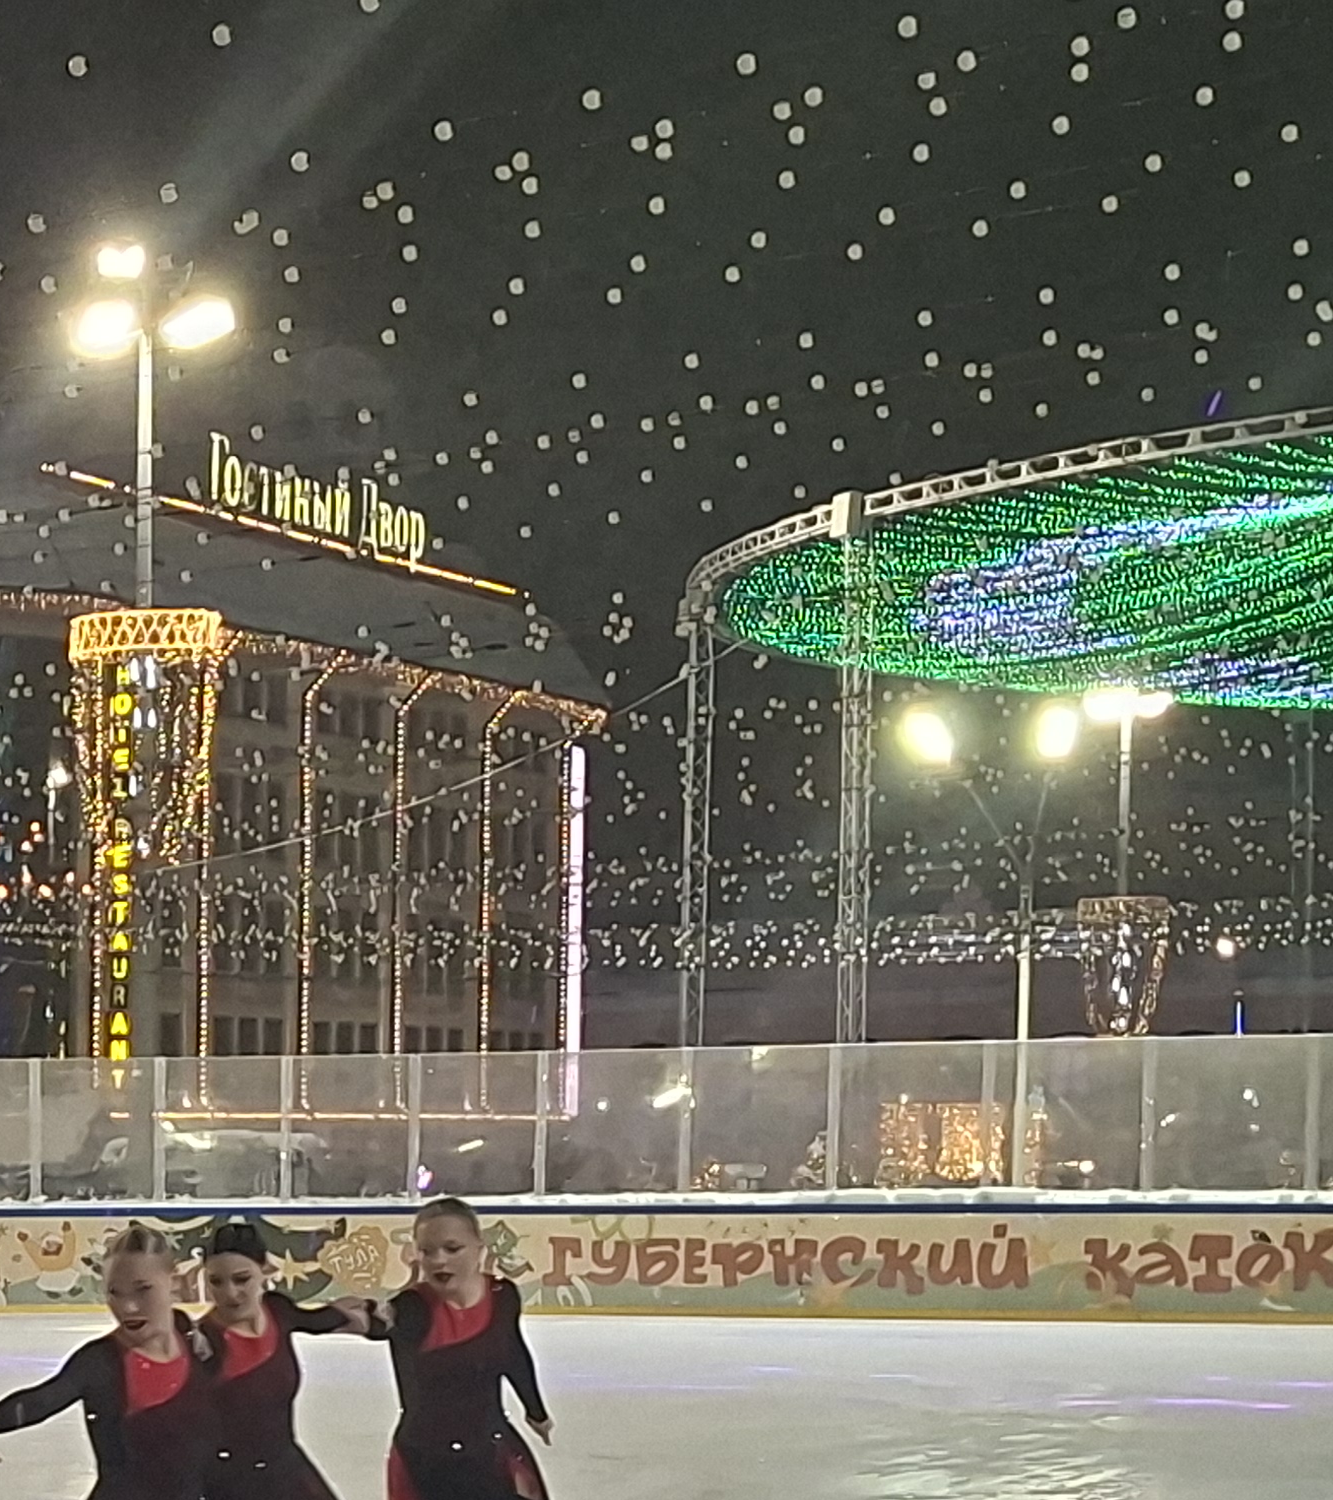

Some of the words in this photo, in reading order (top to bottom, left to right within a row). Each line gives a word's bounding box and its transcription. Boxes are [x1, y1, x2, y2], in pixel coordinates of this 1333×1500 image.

[209, 431, 351, 537] Гостиный
[358, 478, 425, 573] Двор
[111, 817, 132, 1089] RESTAURANT
[328, 1244, 379, 1273] ТУЛА
[542, 1224, 1030, 1295] ГУБЕРНСКИЙ
